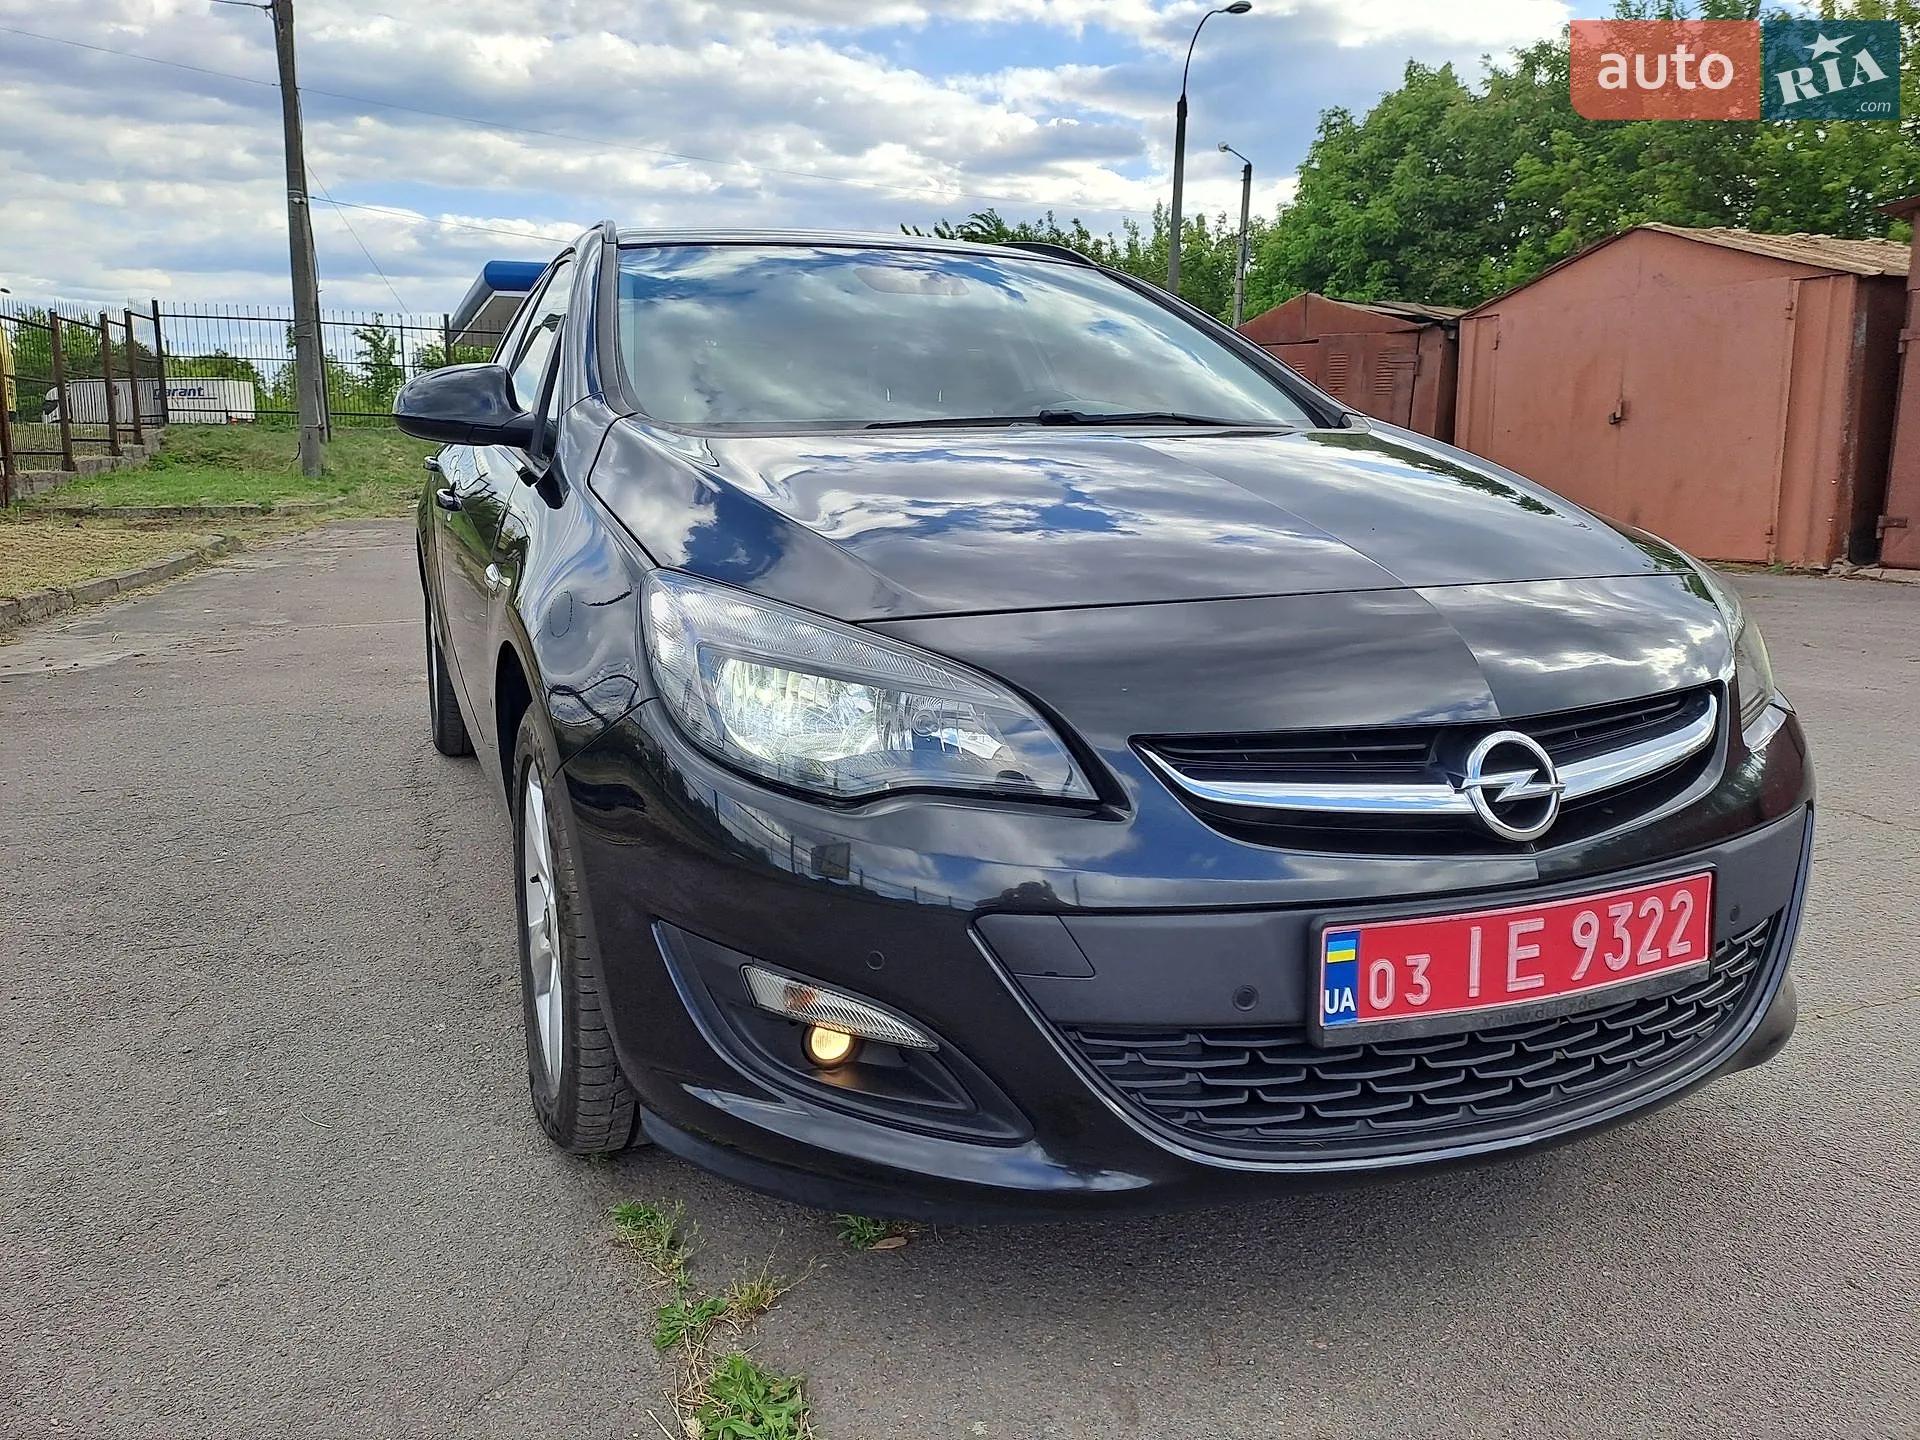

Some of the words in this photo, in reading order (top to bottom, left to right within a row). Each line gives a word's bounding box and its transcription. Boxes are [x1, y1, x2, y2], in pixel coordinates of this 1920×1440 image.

[1369, 954, 1432, 1010] 03
[1468, 918, 1545, 998] IE
[1570, 889, 1695, 981] 9322
[1324, 987, 1356, 1014] UA
